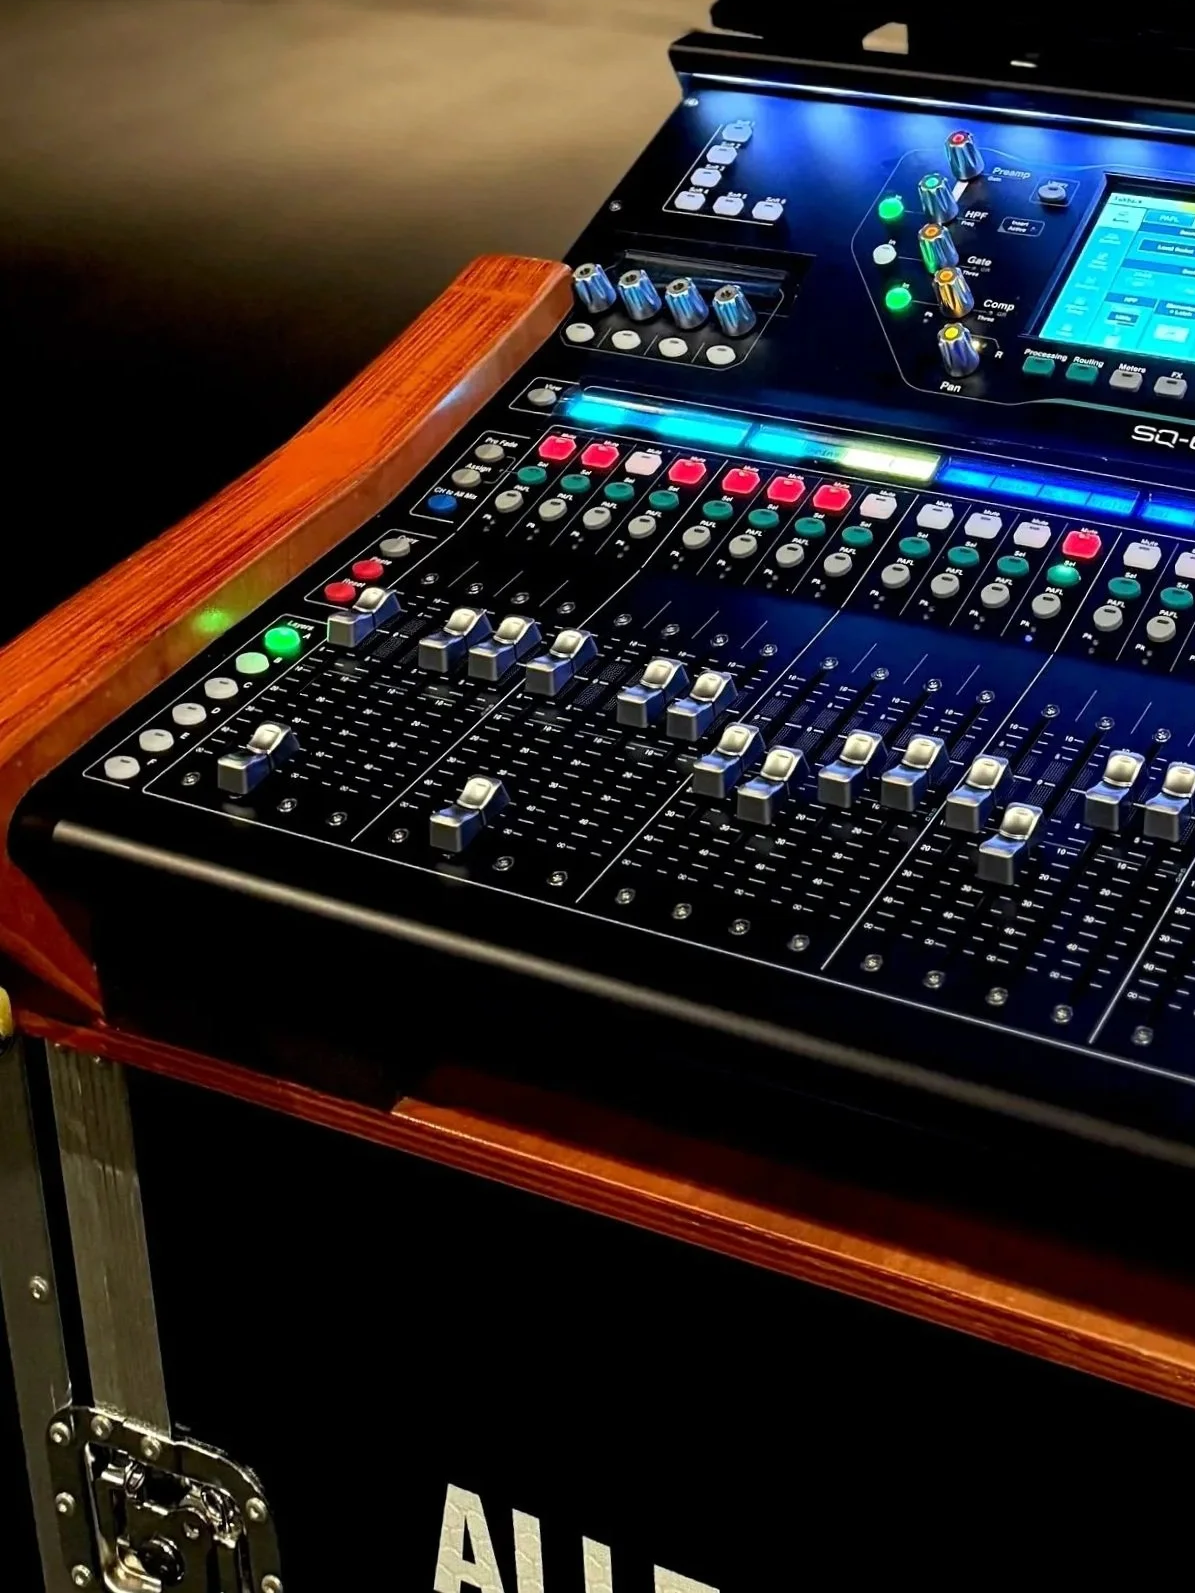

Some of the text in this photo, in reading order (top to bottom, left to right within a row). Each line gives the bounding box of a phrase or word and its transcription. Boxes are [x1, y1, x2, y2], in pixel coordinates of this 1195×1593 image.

[992, 166, 1032, 180] Preamp
[965, 209, 989, 221] HPF
[967, 256, 993, 267] Gate
[983, 299, 1015, 312] Comp
[995, 350, 1004, 358] R
[1023, 348, 1068, 362] Processing
[1073, 356, 1105, 368] Routing
[1119, 362, 1147, 374] Meters
[1171, 371, 1183, 379] FX
[940, 381, 962, 393] Pan
[500, 439, 518, 448] Fade
[465, 463, 492, 473] Assign
[897, 557, 915, 566] PAFL
[945, 567, 964, 576] PAFL
[1125, 571, 1137, 579] Sel
[1045, 586, 1064, 596] PAFL
[1107, 598, 1126, 608] PAFL
[287, 620, 314, 631] Layers
[243, 681, 253, 689] C
[211, 707, 220, 715] D
[180, 732, 190, 740] E
[147, 758, 157, 766] F
[1159, 935, 1170, 943] 30
[433, 1483, 721, 1593] AL
